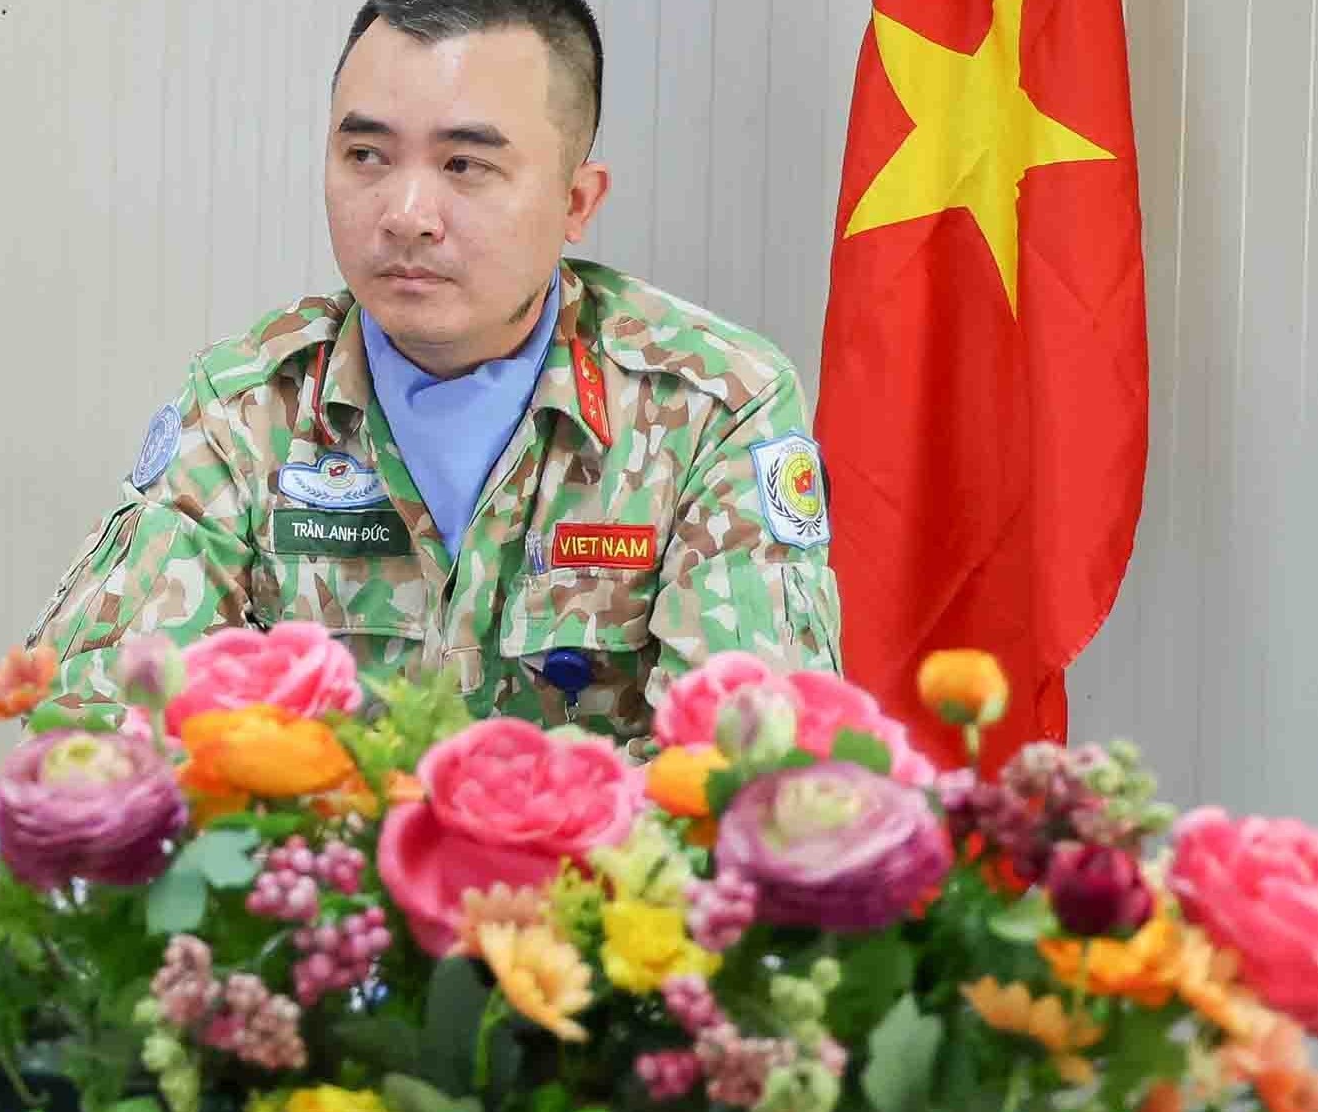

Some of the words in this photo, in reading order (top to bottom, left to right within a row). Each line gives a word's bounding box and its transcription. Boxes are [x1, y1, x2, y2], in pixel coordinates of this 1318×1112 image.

[291, 518, 324, 539] TRẦN
[328, 525, 357, 542] ANH
[360, 522, 390, 541] ĐỨC
[559, 535, 599, 556] VIET
[601, 536, 648, 558] NAM
